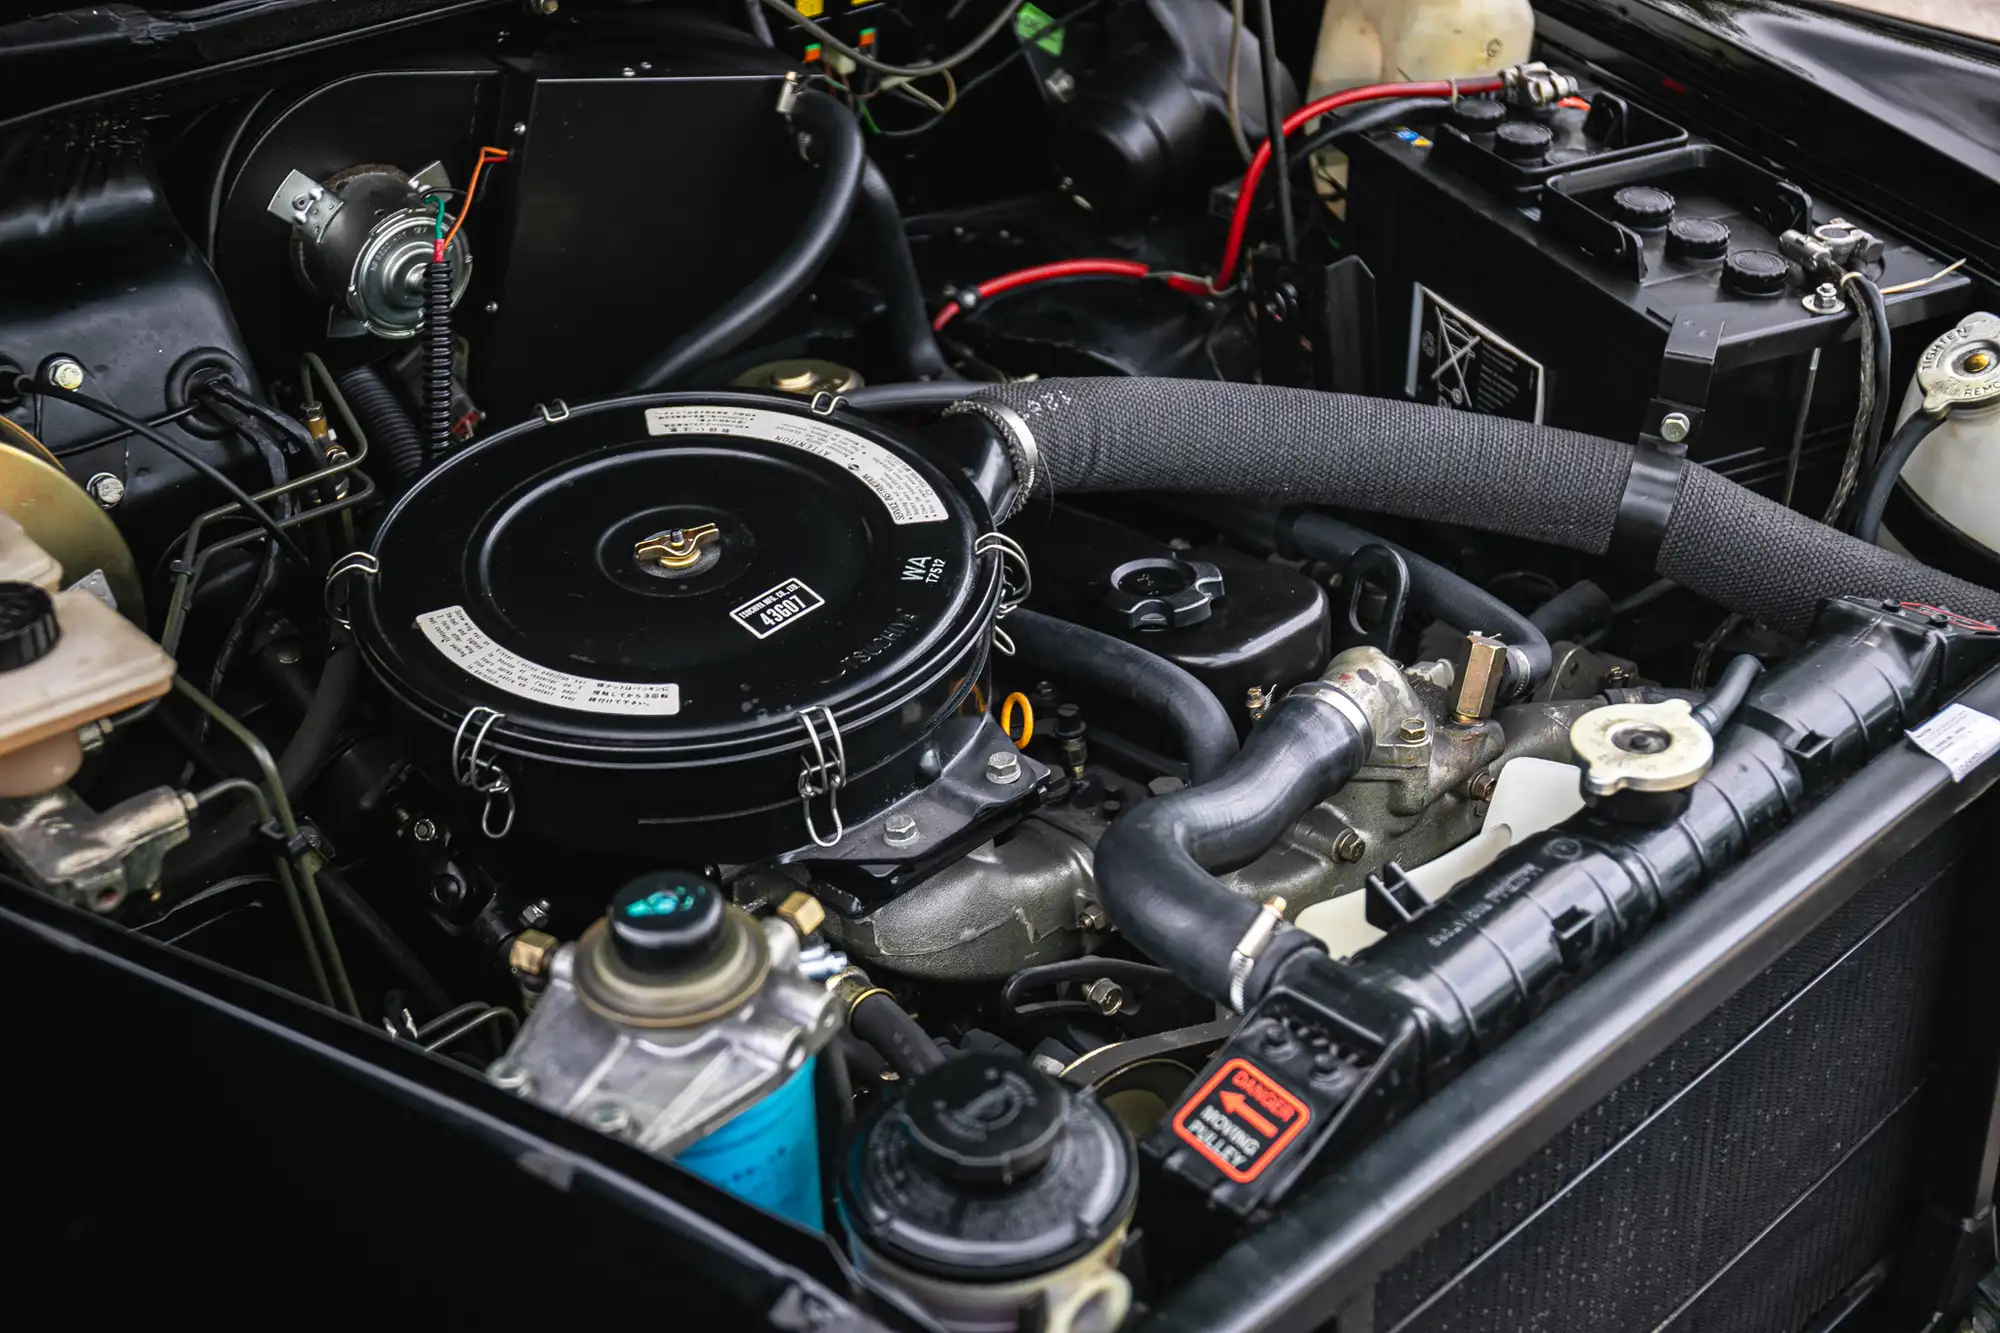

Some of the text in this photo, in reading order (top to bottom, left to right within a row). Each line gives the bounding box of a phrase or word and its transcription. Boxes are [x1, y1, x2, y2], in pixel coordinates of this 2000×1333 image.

[1921, 327, 1968, 370] TIGHTEN
[774, 435, 832, 456] ATTENTION
[900, 556, 932, 580] WA
[925, 558, 946, 583] T7512
[738, 602, 766, 619] TSUCHIYA
[762, 595, 779, 606] MFG.
[760, 595, 806, 626] 43G07
[1231, 1070, 1295, 1122] DANGER
[1188, 1119, 1248, 1168] PULLEY
[1200, 1105, 1260, 1157] MOVING
